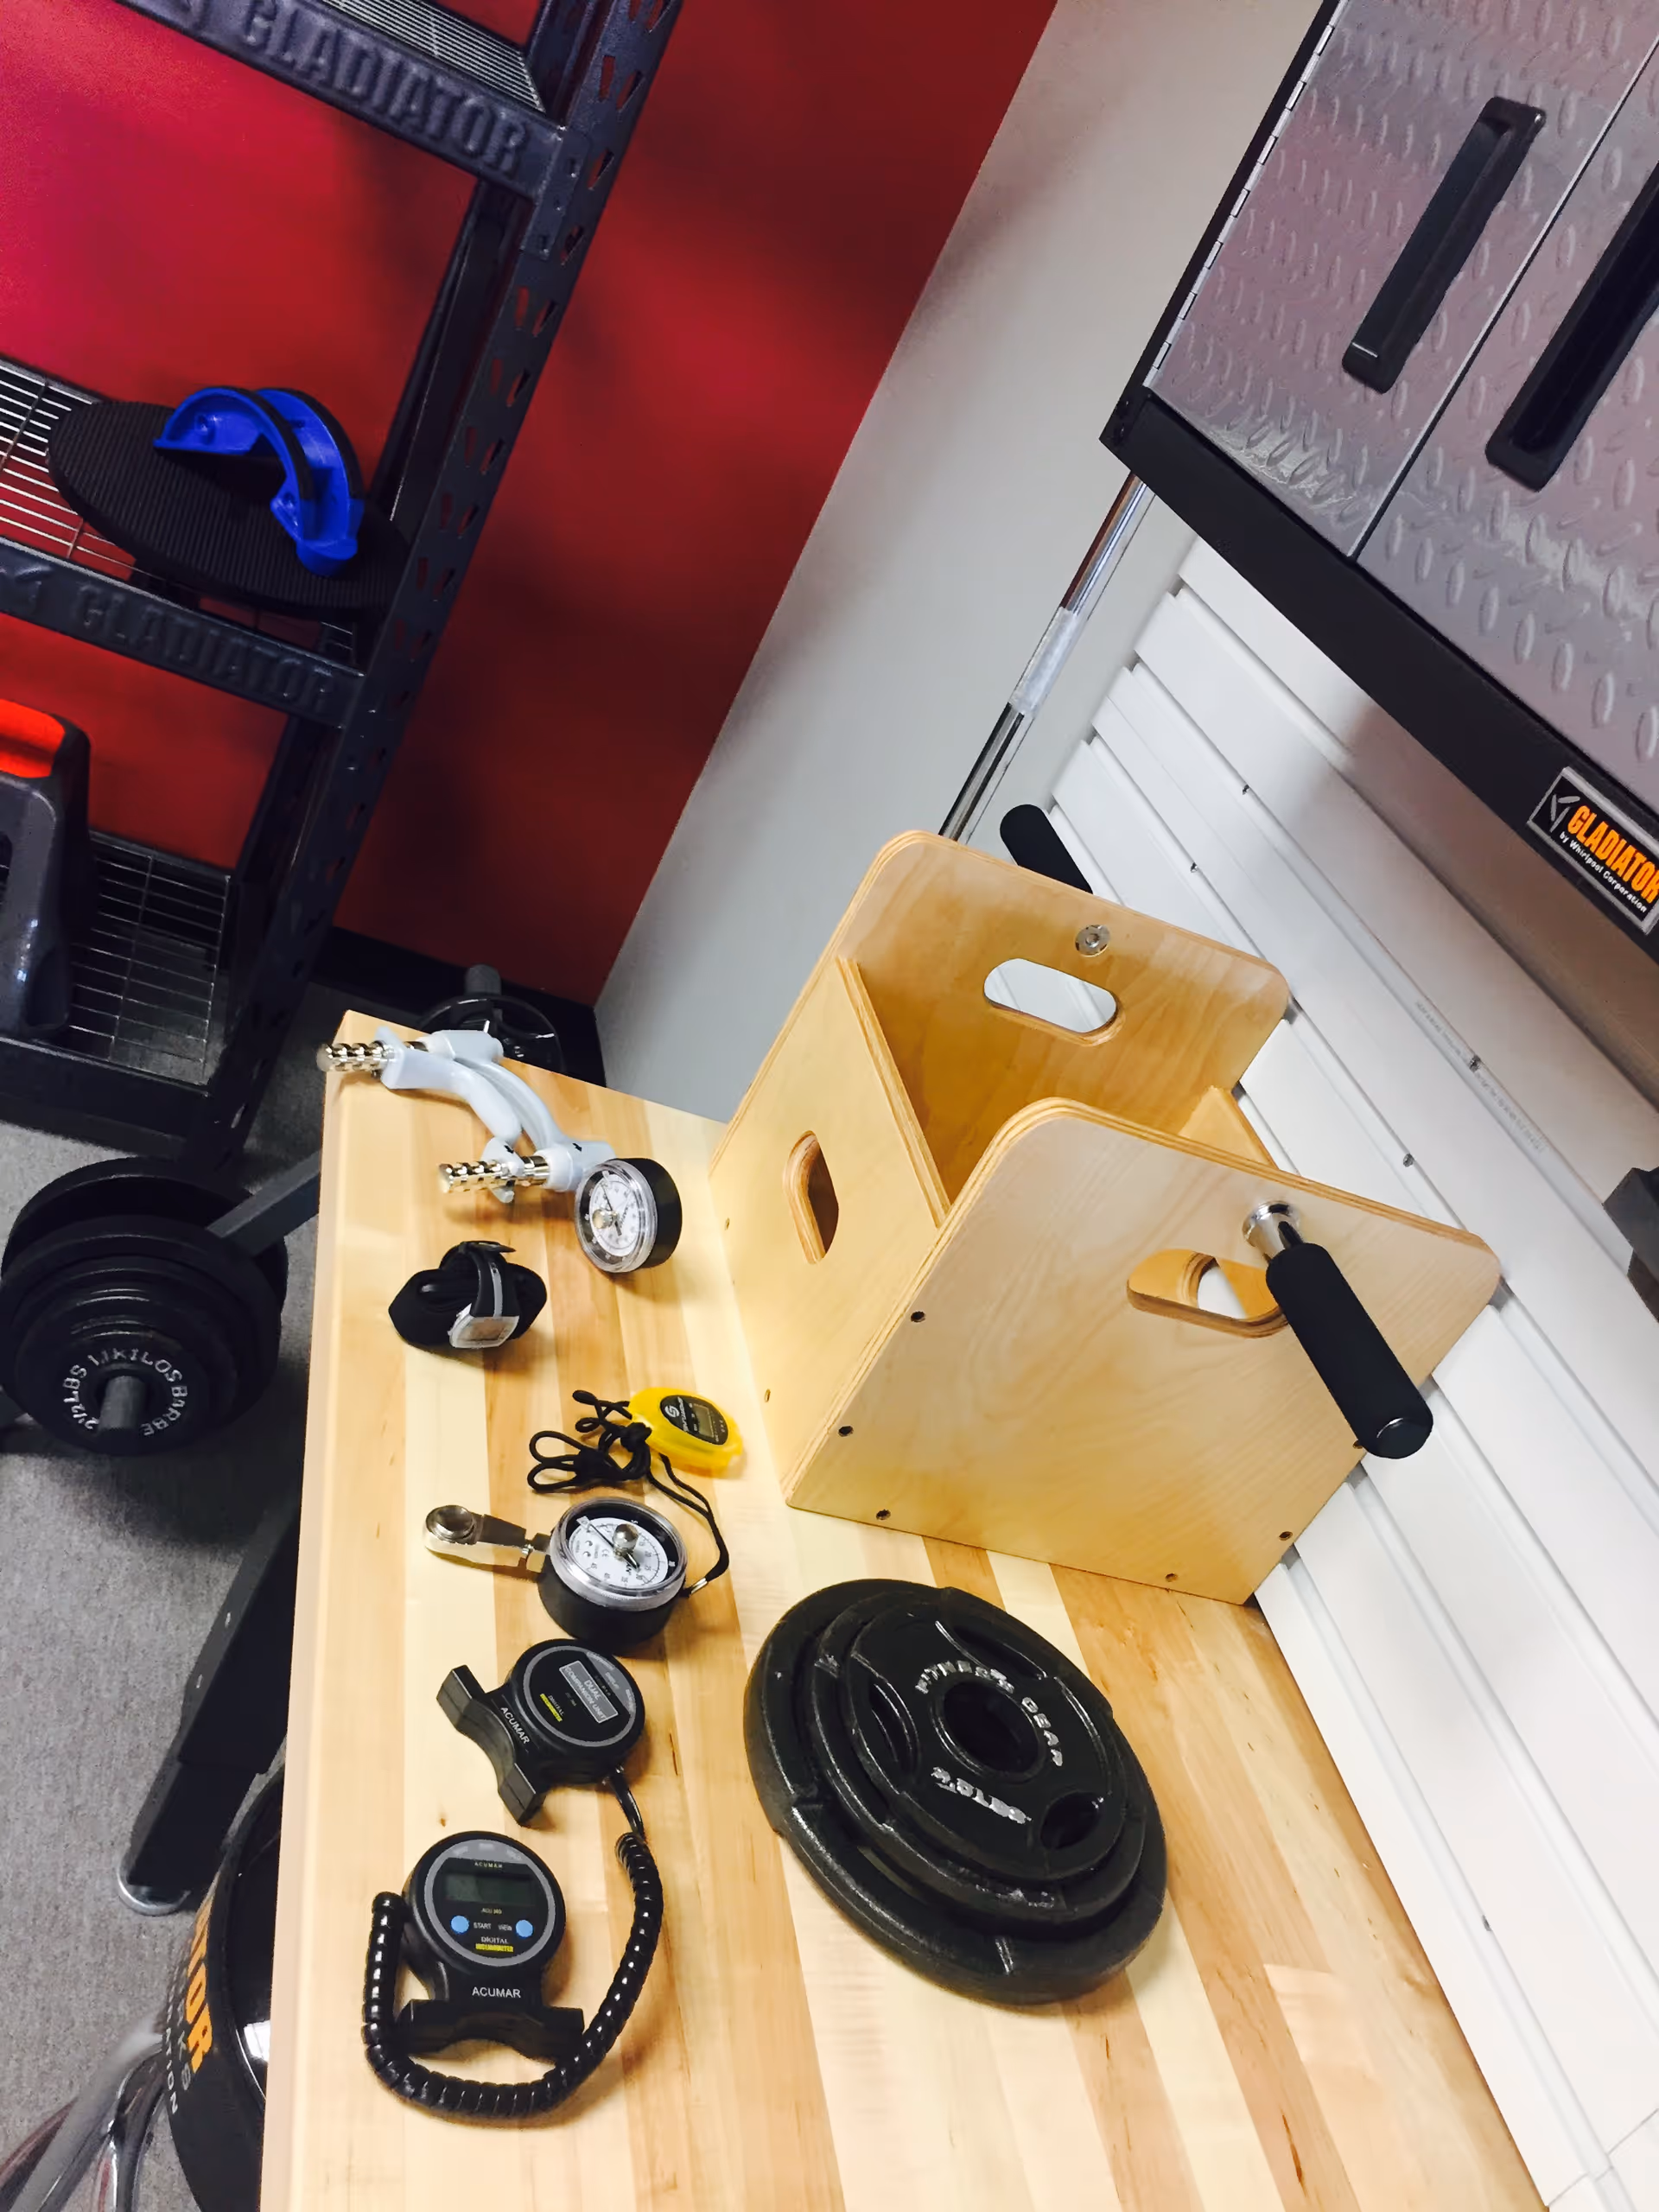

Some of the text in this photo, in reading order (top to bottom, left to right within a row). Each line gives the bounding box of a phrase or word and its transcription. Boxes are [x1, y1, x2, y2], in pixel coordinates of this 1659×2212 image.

[238, 0, 529, 179] GLADIATOR
[75, 581, 337, 711] GLADIATOR
[1559, 831, 1648, 913] by Whirlpool Corporation
[1567, 805, 1659, 905] GLADIATOR
[501, 1707, 531, 1745] ACUMAR
[472, 1986, 521, 1999] ACUMAR
